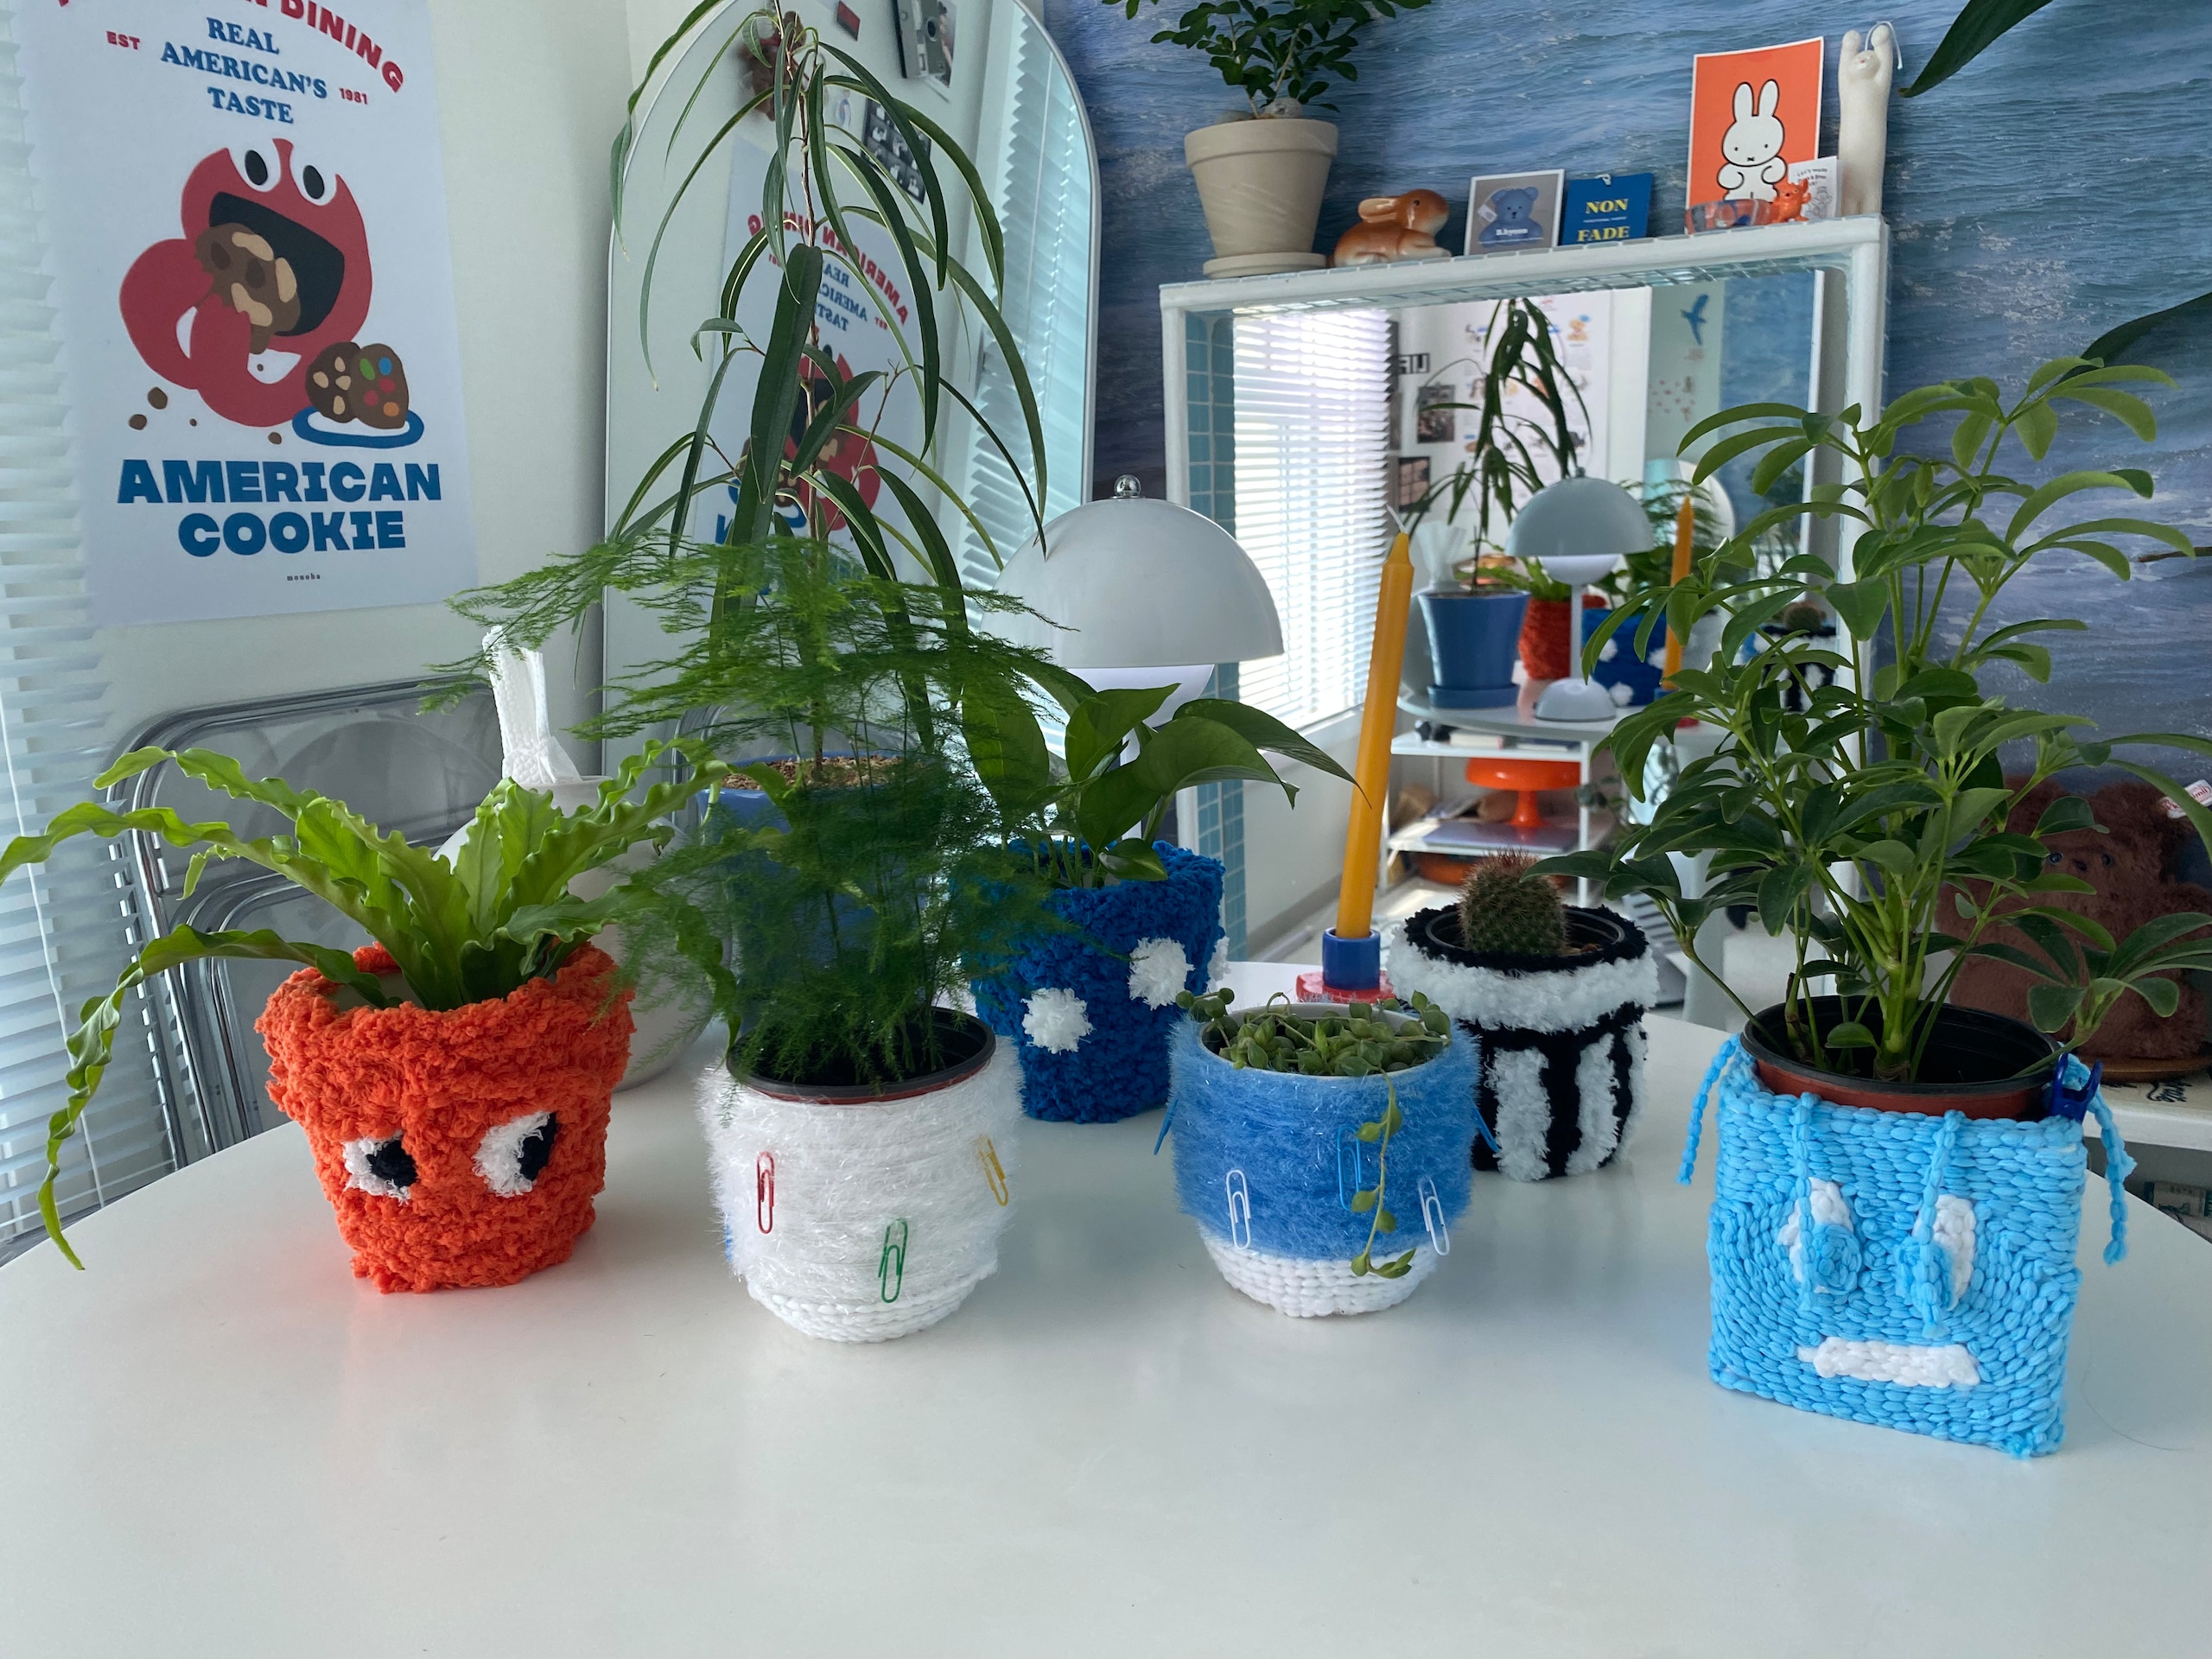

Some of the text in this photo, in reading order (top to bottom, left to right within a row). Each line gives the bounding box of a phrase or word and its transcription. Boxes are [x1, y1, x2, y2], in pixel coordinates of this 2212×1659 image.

[105, 30, 140, 50] EST
[207, 17, 280, 54] REAL
[281, 0, 404, 93] DINING
[161, 41, 327, 99] AMERICAN'S
[207, 88, 293, 124] TASTE
[339, 87, 368, 105] 1981
[1585, 199, 1629, 214] NON
[1577, 226, 1630, 242] FADE
[117, 459, 442, 504] AMERICAN
[178, 510, 406, 557] COOKIE
